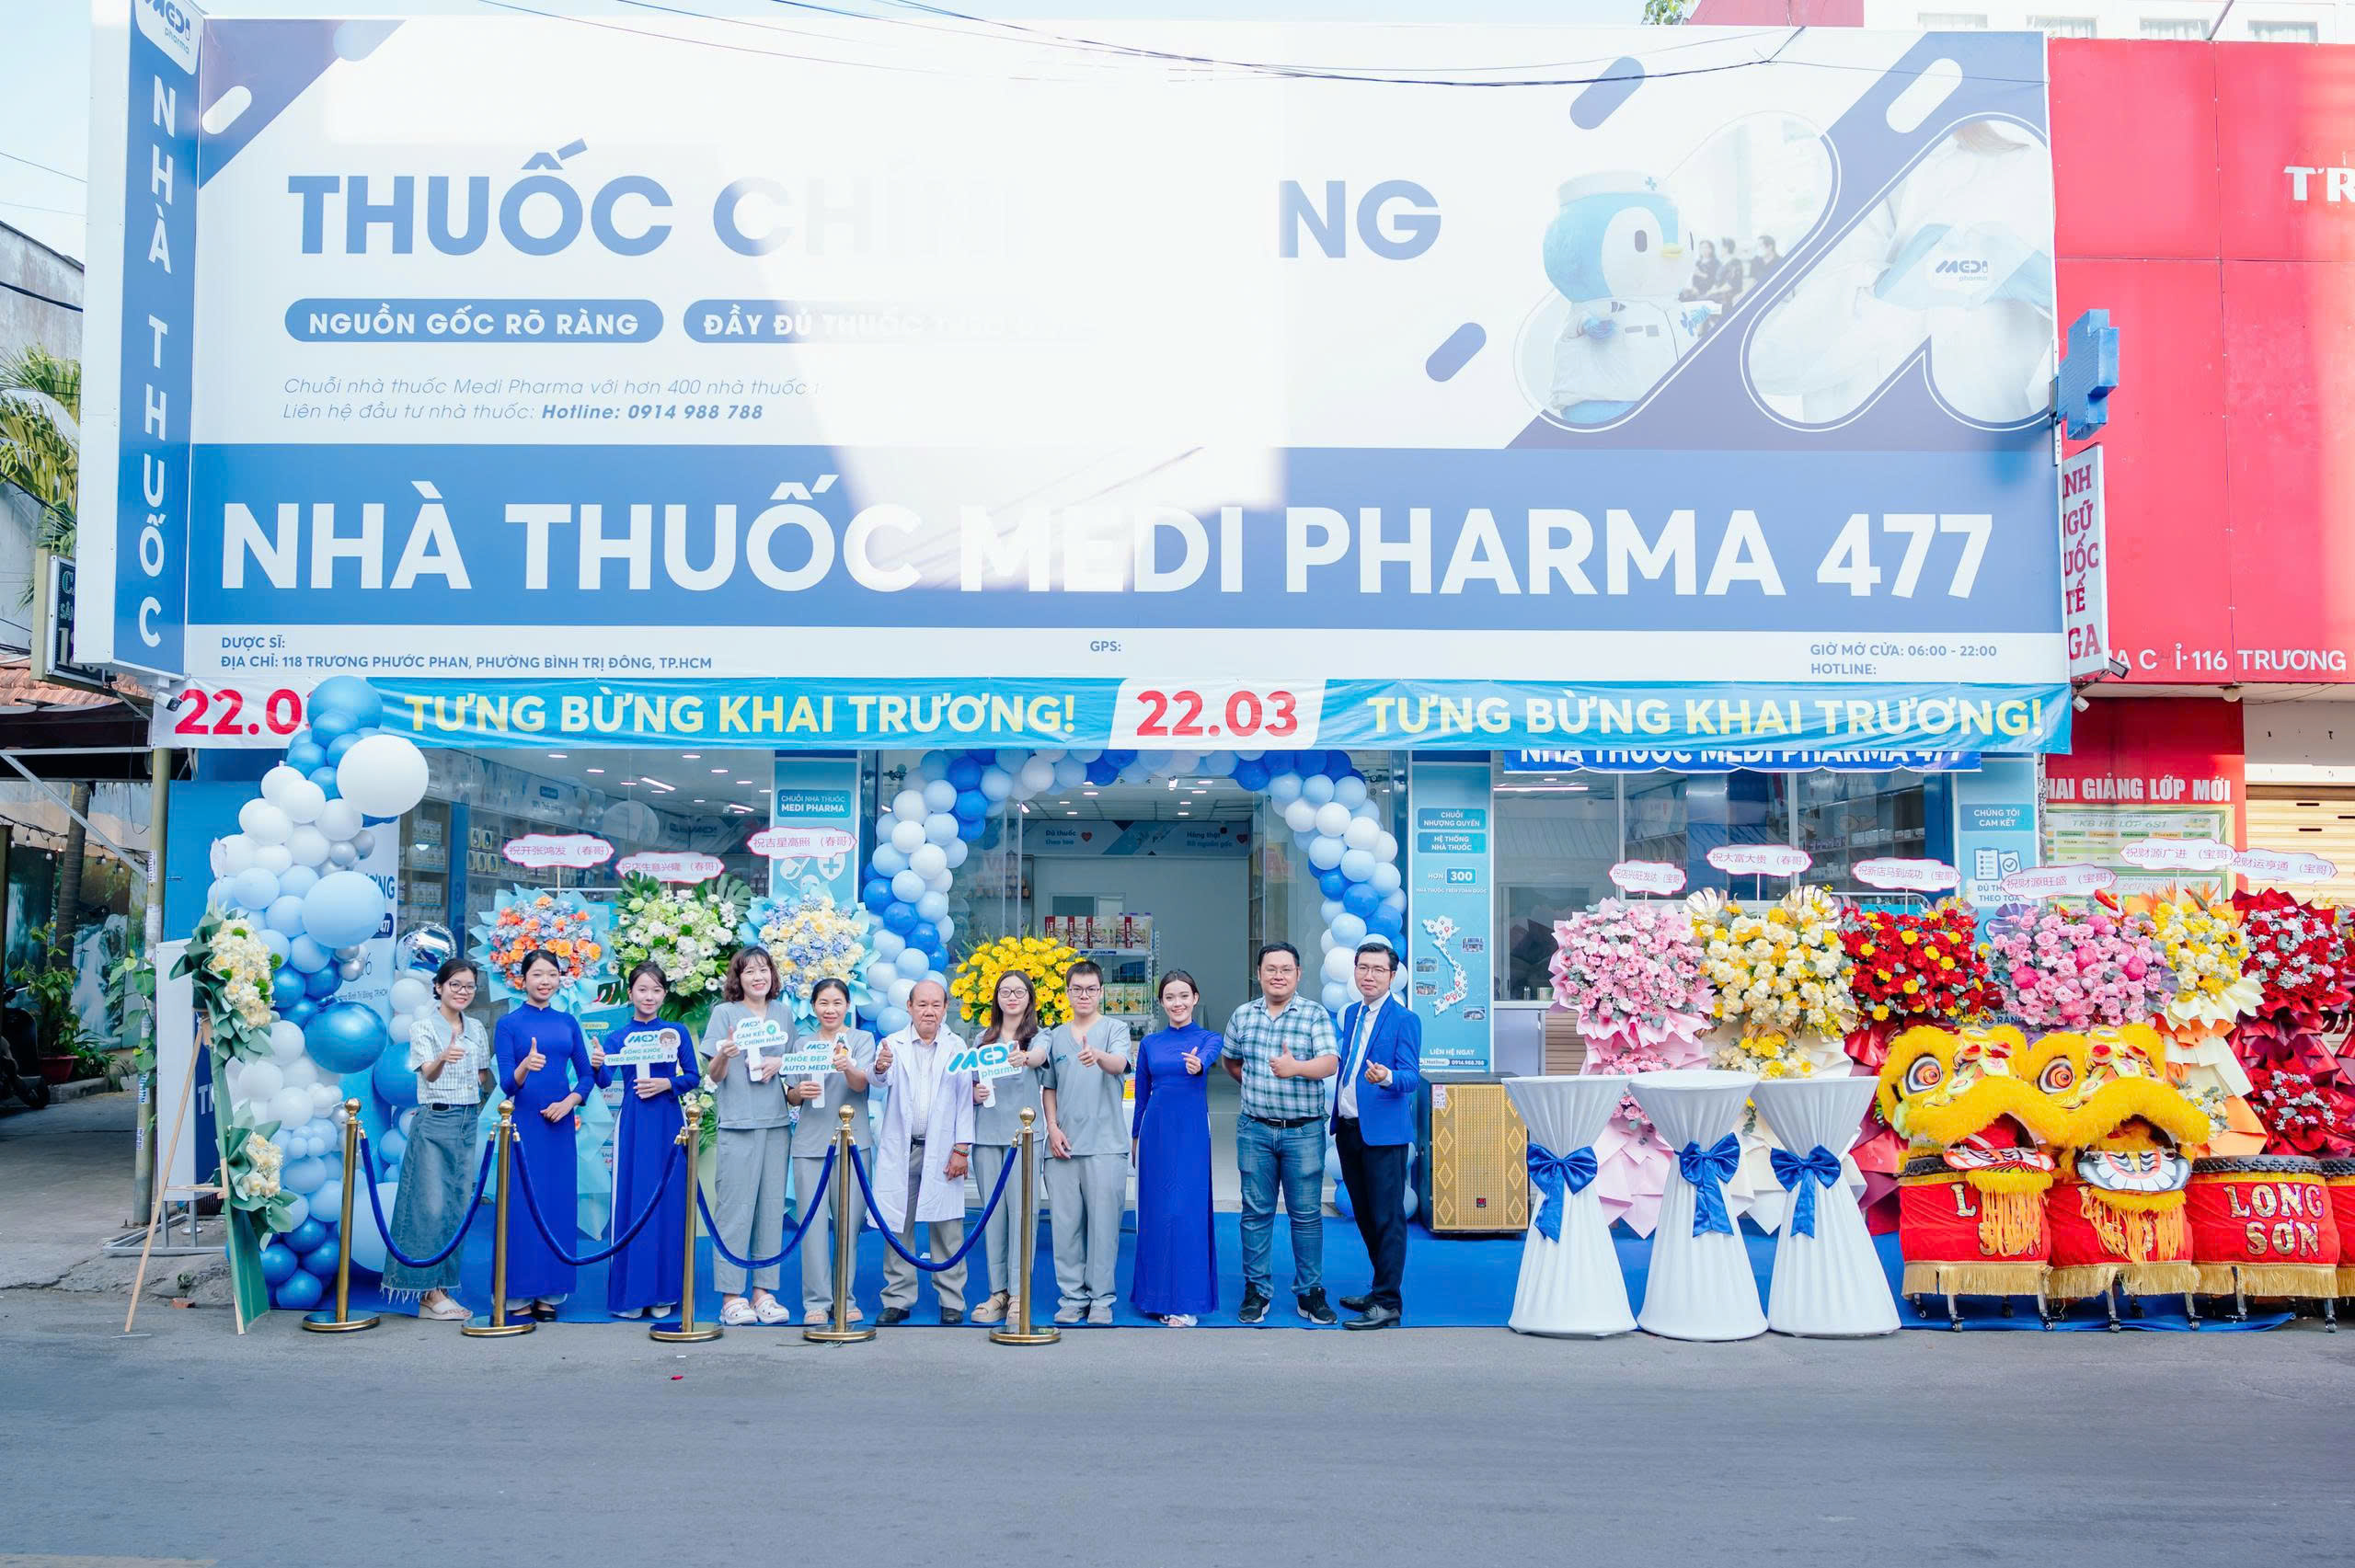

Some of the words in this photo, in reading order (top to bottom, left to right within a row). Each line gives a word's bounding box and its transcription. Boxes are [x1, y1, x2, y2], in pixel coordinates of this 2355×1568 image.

[288, 138, 672, 257] THUỐC
[309, 302, 415, 335] NGUỒN
[426, 303, 494, 335] GỐC
[506, 308, 546, 335] RÕ
[557, 307, 638, 335] RÀNG
[703, 303, 763, 336] ĐẦY
[773, 308, 811, 336] ĐỦ
[284, 375, 340, 395] Chuỗi
[347, 378, 385, 395] nhà
[391, 377, 447, 395] thuốc
[454, 379, 502, 395] Medi
[508, 379, 583, 395] Pharma
[591, 378, 618, 395] với
[624, 380, 661, 395] hơn
[667, 379, 701, 395] 400
[706, 379, 743, 395] nhà
[751, 377, 808, 395] thuốc
[283, 404, 321, 419] Liên
[327, 404, 352, 421] hệ
[359, 401, 396, 419] đầu
[405, 405, 425, 419] tư
[429, 404, 465, 419] nhà
[473, 402, 534, 419] thuốc:
[542, 404, 621, 419] Hotline:
[628, 405, 676, 419] 0914
[684, 405, 719, 419] 988
[728, 405, 763, 419] 788
[2062, 464, 2092, 499] NH
[222, 480, 472, 590] NHÀ
[505, 474, 922, 593] THUỐC
[959, 505, 1243, 594] MEDI
[1287, 507, 1786, 597] PHARMA
[1816, 513, 1993, 600] 477
[2063, 532, 2099, 577] UỐC
[221, 636, 265, 651] DƯỢC
[269, 634, 286, 649] SĨ:
[1089, 639, 1122, 653] GPS:
[1809, 641, 1837, 656] GIỜ
[1841, 641, 1867, 656] MỞ
[1869, 641, 1904, 657] CỬA:
[1908, 646, 1947, 657] 06:00
[1959, 646, 1997, 657] 22:00
[221, 656, 246, 670] ĐỊA
[249, 652, 279, 668] CHỈ:
[282, 656, 303, 668] 118
[306, 655, 369, 669] TRƯƠNG
[372, 653, 425, 669] PHƯỚC
[429, 656, 472, 670] PHAN,
[477, 654, 540, 670] PHƯỜNG
[544, 654, 579, 669] BÌNH
[582, 657, 604, 671] TRỊ
[608, 654, 655, 670] ĐÔNG,
[659, 657, 712, 670] TP.HCM
[2237, 648, 2347, 670] TRƯƠNG
[1810, 663, 1877, 675] HOTLINE:
[174, 688, 314, 736] 22.0
[405, 693, 546, 733] TƯNG
[561, 688, 706, 734] BỪNG
[719, 695, 833, 733] KHAI
[847, 692, 1074, 734] TRƯƠNG!
[1136, 691, 1298, 737] 22.03
[1367, 694, 1511, 734] TƯNG
[1525, 690, 1670, 735] BỪNG
[1686, 699, 1801, 736] KHAI
[1815, 696, 2043, 737] TRƯƠNG!
[2046, 778, 2075, 800] HAI
[2082, 773, 2143, 800] GIẢNG
[2150, 773, 2186, 800] LỚP
[2193, 775, 2231, 802] MỚI
[781, 794, 804, 802] CHUỖI
[781, 804, 804, 812] MEDI
[806, 804, 845, 813] PHARMA
[1973, 808, 2005, 817] CHÚNG
[2006, 808, 2020, 817] TÔI
[1979, 818, 1999, 827] CAM
[2000, 818, 2016, 827] KẾT
[2072, 819, 2096, 828] TKB
[1448, 842, 1472, 851] THUỐC
[1450, 871, 1473, 881] 300
[1979, 894, 2002, 902] THEO
[1429, 1047, 1445, 1056] LIÊN
[783, 1064, 806, 1072] AUTO
[809, 1063, 830, 1071] MEDI
[2223, 1183, 2326, 1219] LONG
[2244, 1219, 2320, 1257] SƠN
